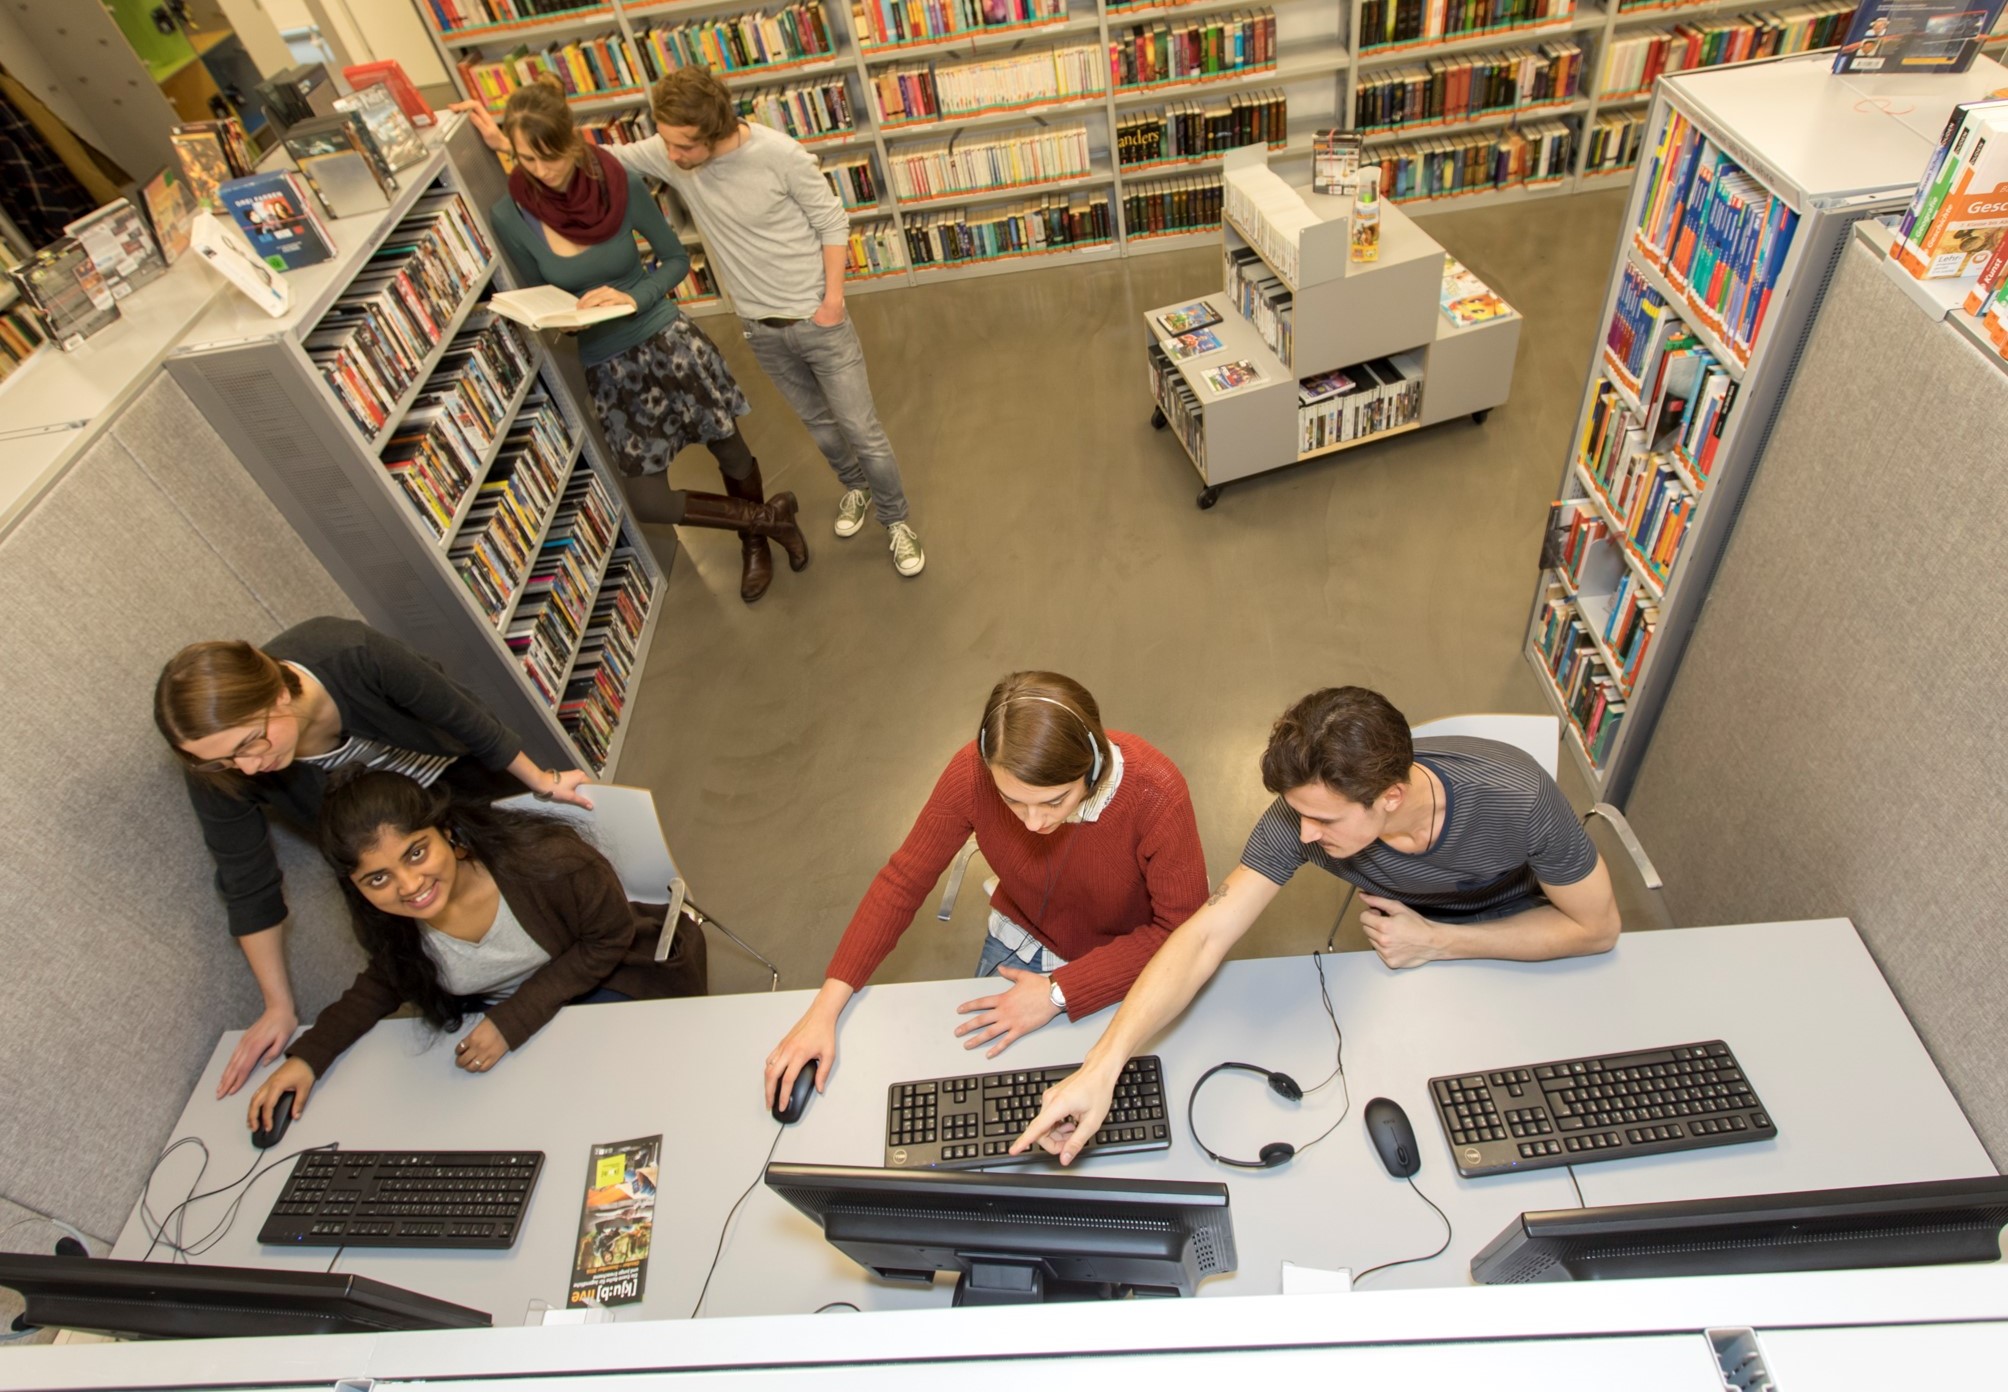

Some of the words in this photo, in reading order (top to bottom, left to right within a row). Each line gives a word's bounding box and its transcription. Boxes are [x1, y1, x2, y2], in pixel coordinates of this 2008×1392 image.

[1118, 129, 1160, 148] anders
[1915, 196, 1938, 239] Geografie
[1926, 203, 1954, 249] Geschichte
[1984, 258, 2003, 284] Kunst
[596, 1279, 638, 1302] [kju:b]
